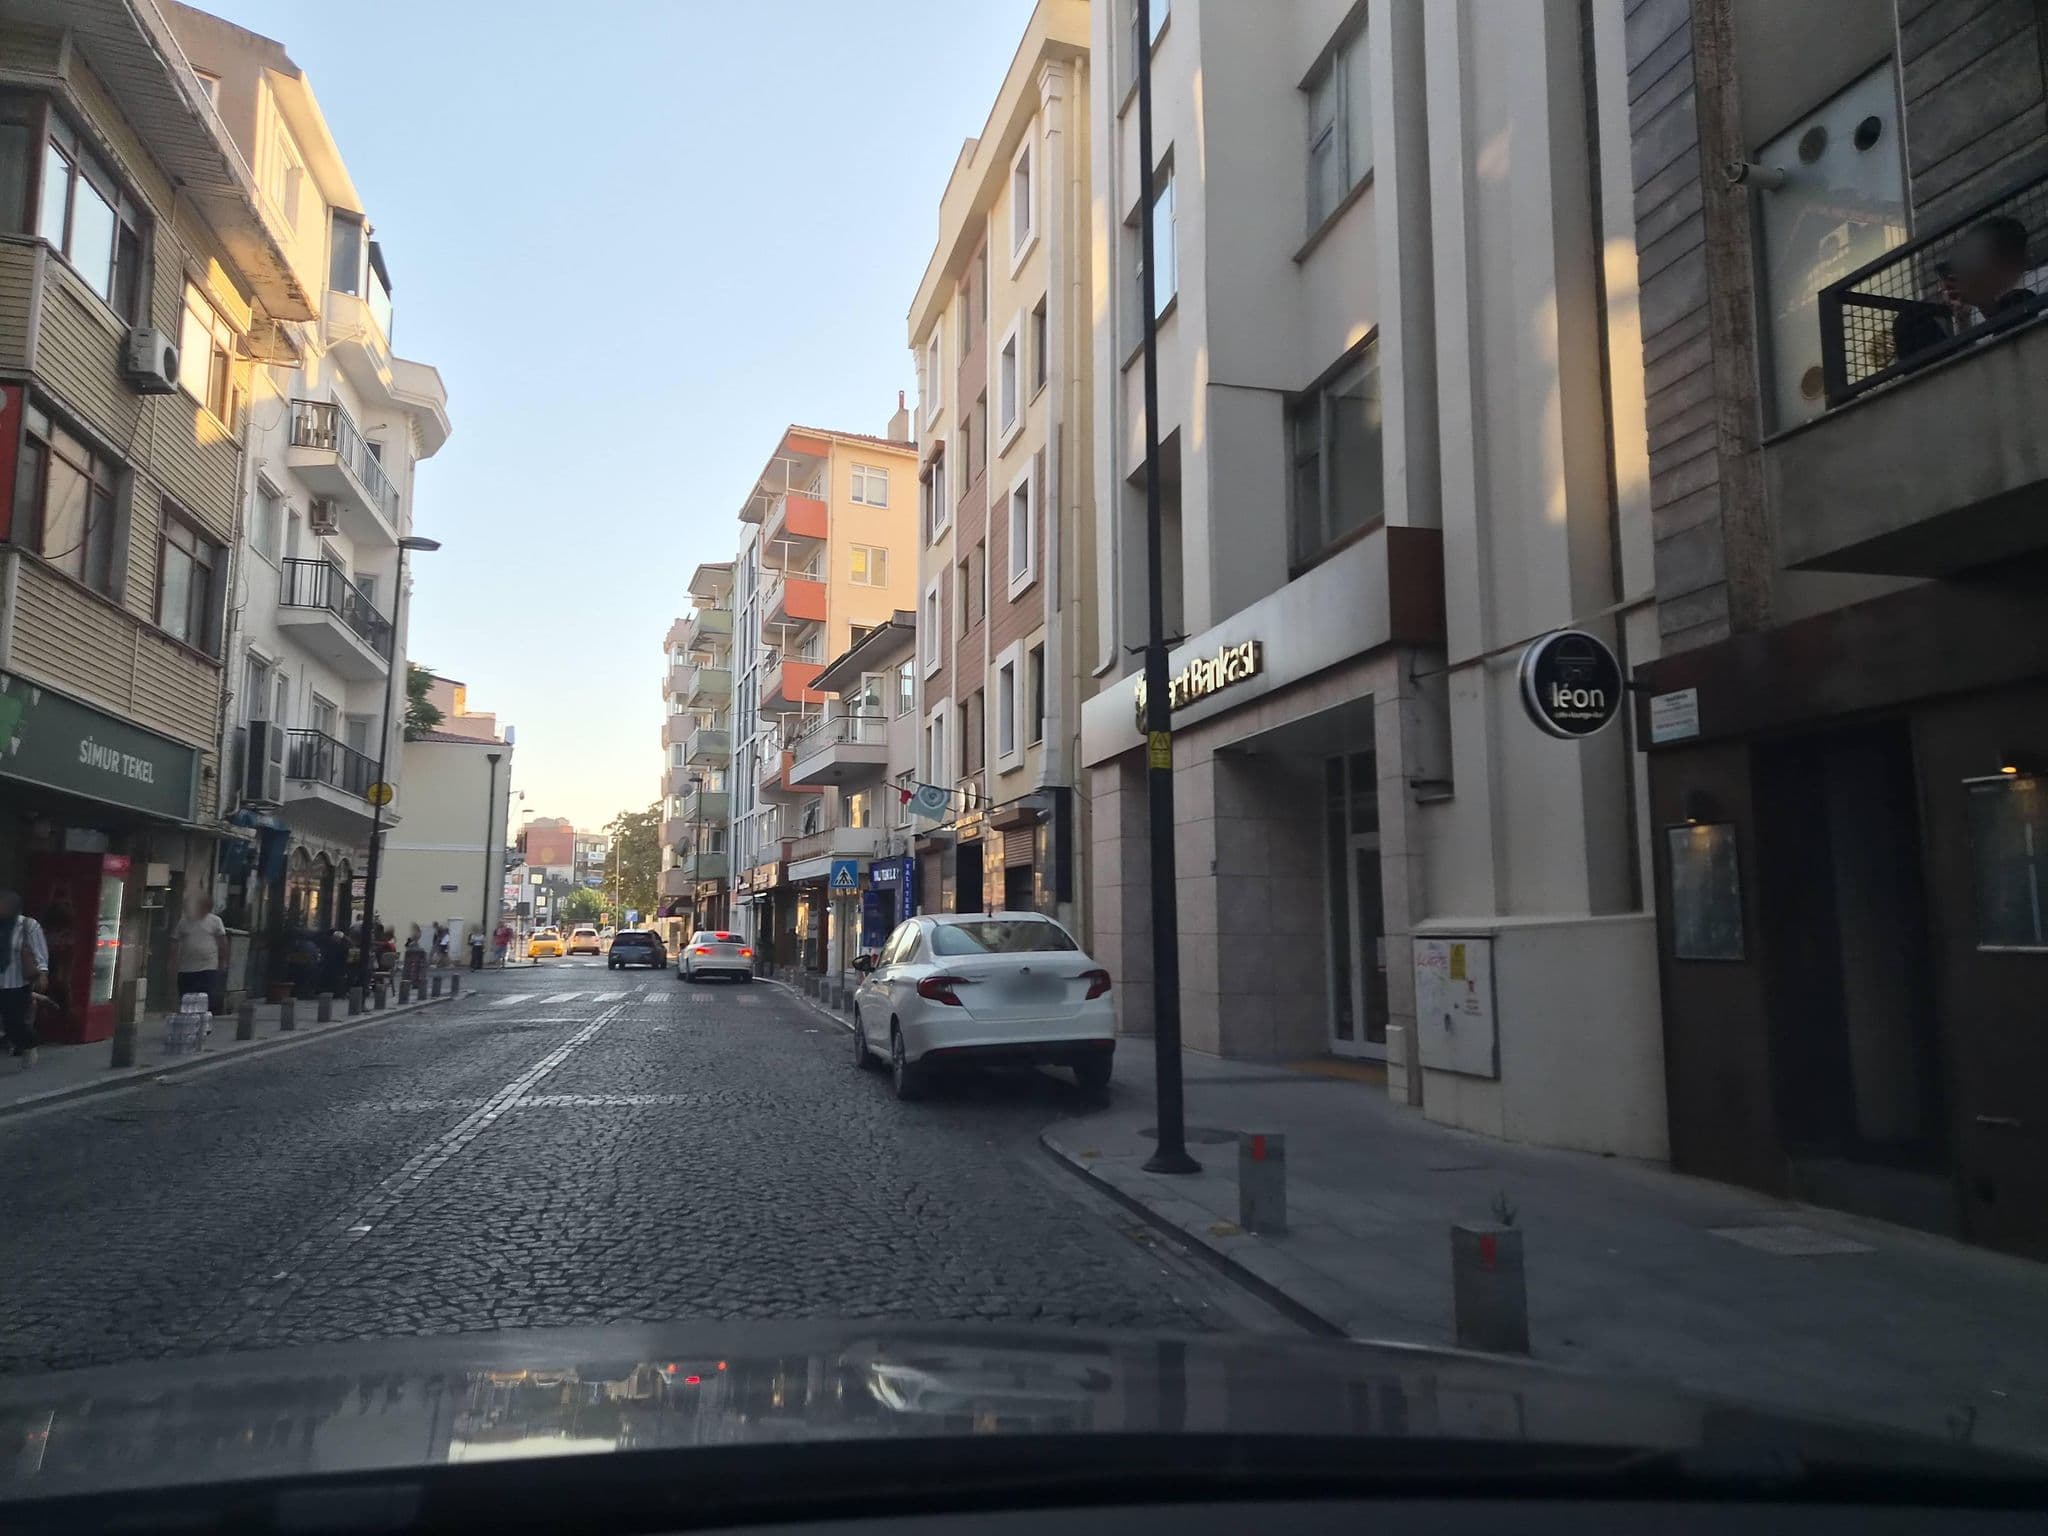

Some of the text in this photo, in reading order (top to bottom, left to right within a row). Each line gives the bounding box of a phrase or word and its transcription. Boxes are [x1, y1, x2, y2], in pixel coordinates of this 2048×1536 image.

[1190, 640, 1255, 695] Bankası
[1551, 681, 1605, 709] léon
[79, 735, 154, 784] SİMUR TEKEL
